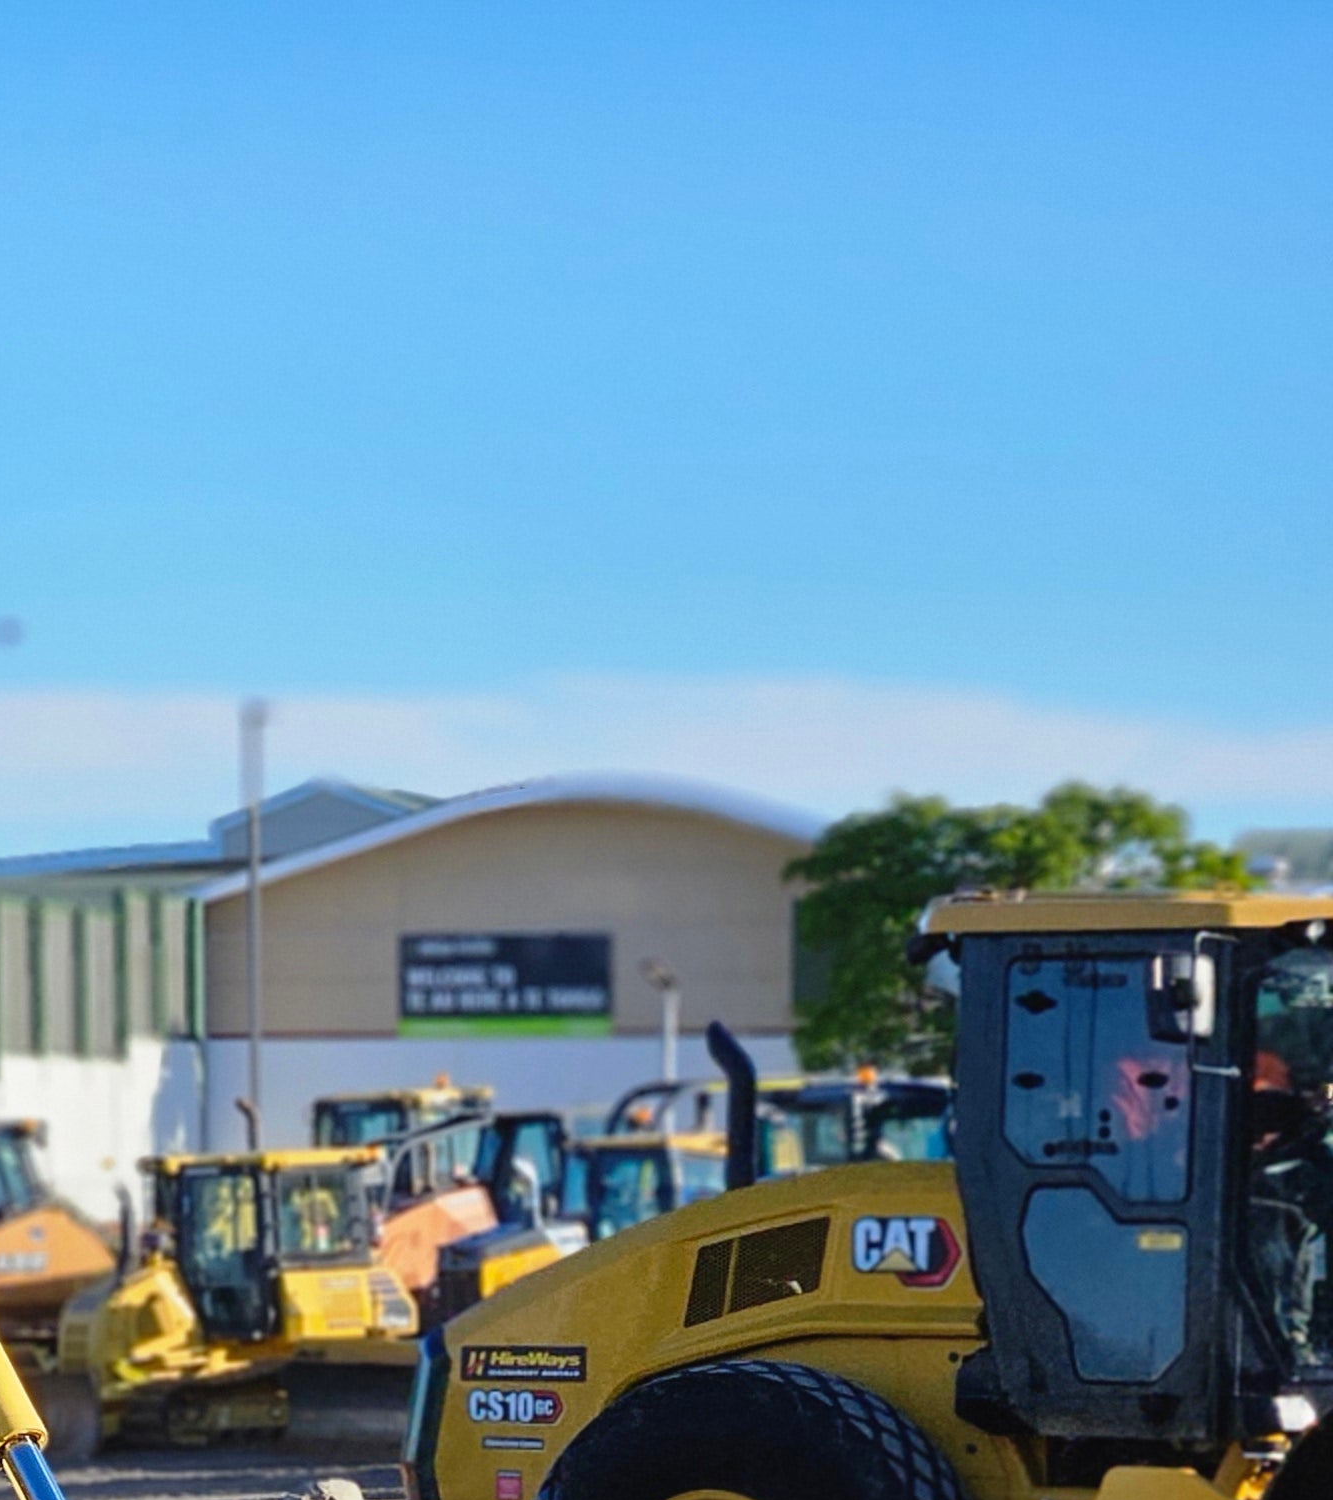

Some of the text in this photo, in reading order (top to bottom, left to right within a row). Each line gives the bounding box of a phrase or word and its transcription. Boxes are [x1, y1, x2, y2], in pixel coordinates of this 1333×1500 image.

[854, 1218, 936, 1271] CAT
[490, 1352, 580, 1369] HireWays
[469, 1390, 534, 1423] CS10
